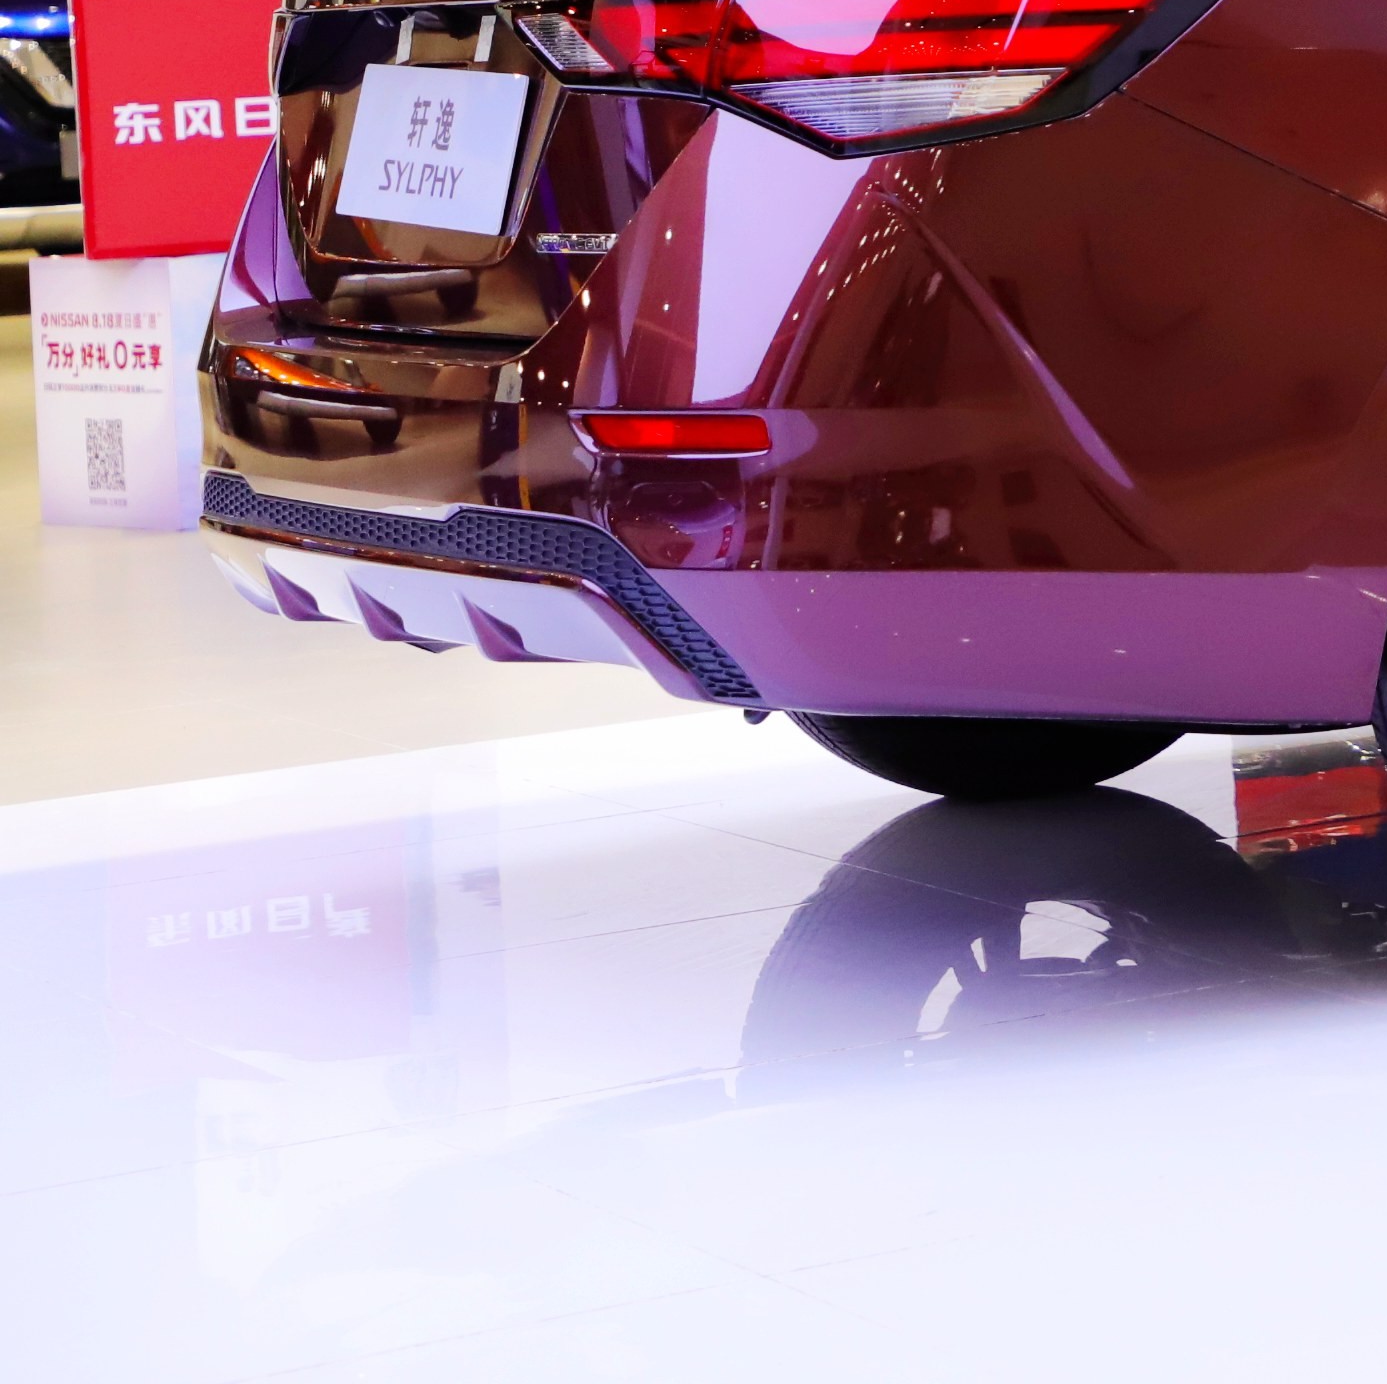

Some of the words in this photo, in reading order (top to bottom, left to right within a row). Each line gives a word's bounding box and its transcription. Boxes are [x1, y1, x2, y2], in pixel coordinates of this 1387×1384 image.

[407, 96, 455, 150] 轩逸
[378, 159, 464, 200] SYLPHY
[50, 312, 89, 328] NISSAN
